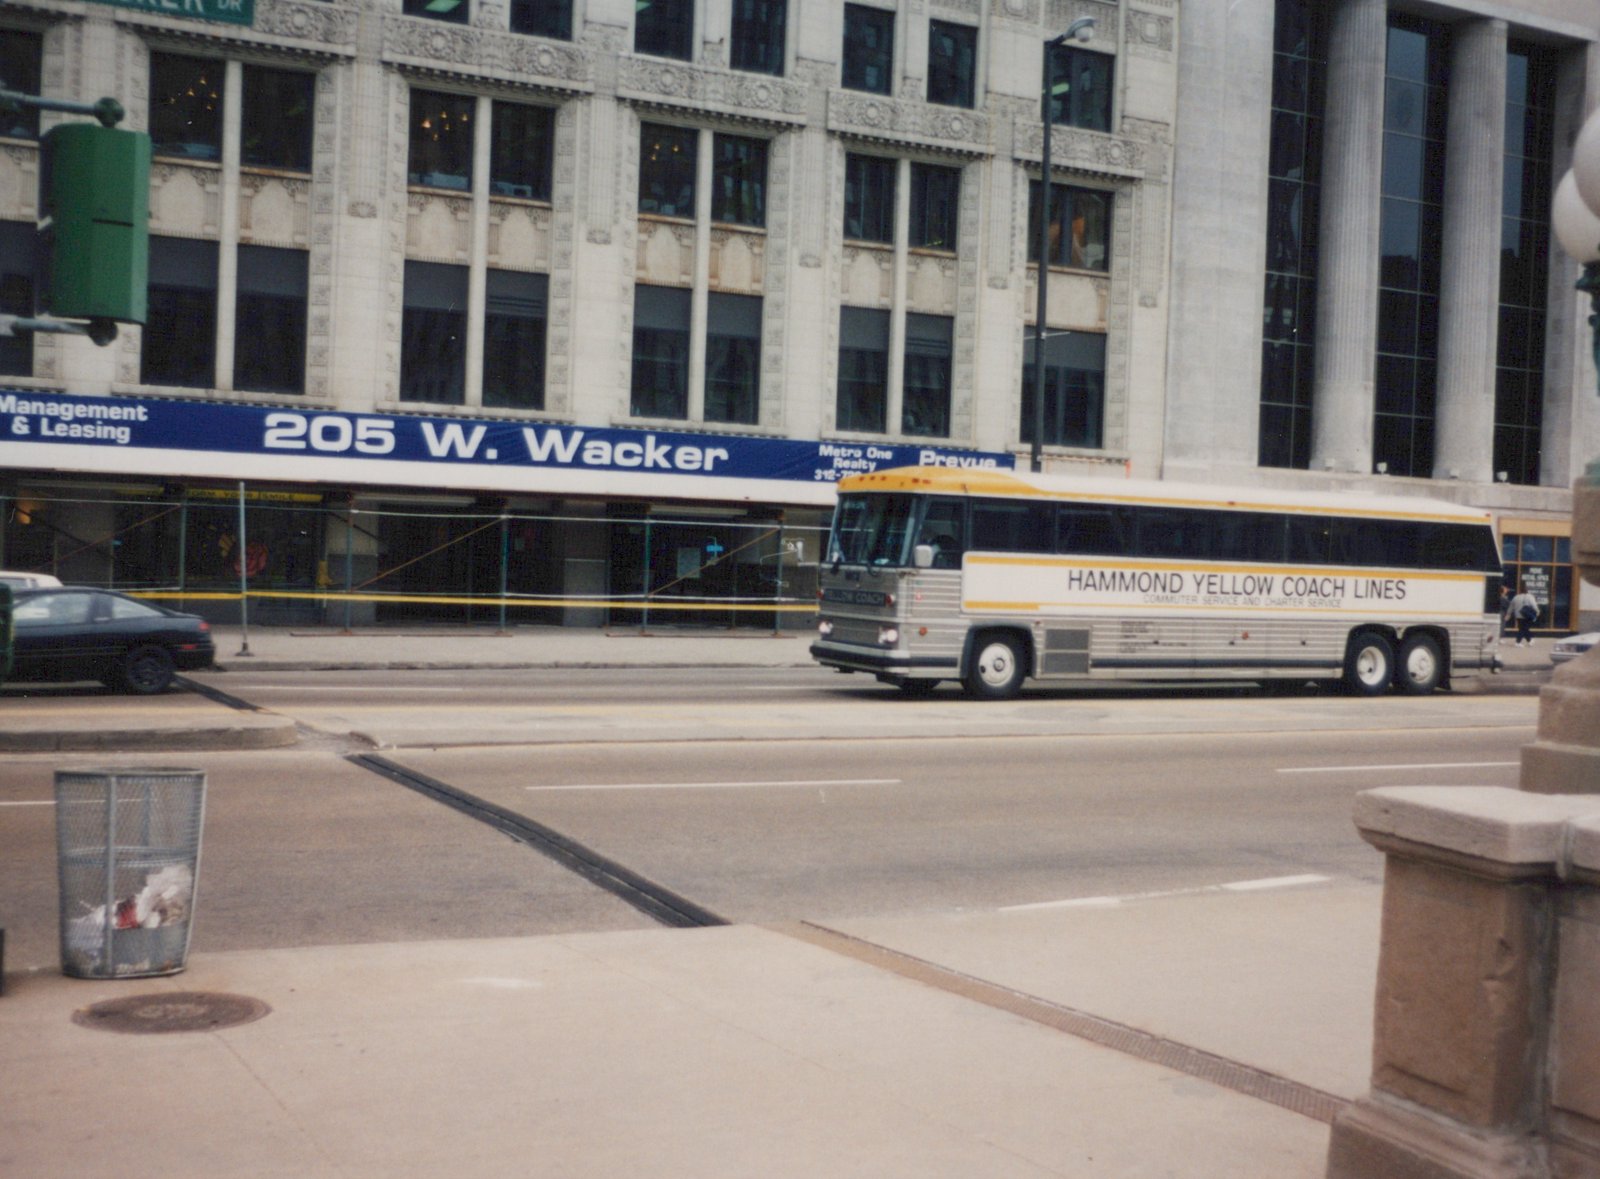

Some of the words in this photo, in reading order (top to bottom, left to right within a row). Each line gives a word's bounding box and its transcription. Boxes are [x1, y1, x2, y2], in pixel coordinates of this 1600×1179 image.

[0, 394, 148, 421] Management
[11, 416, 31, 435] &
[41, 417, 131, 444] Leasing
[264, 413, 395, 454] 205
[420, 421, 498, 460] W.
[522, 426, 729, 471] Wacker
[819, 444, 862, 458] Metro
[866, 447, 893, 460] One
[833, 457, 876, 473] Realty
[919, 451, 997, 467] Prevue
[1068, 569, 1184, 594] HAMMOND
[1193, 573, 1274, 596] YELLOW
[1282, 576, 1346, 598] COACH
[1354, 579, 1406, 600] LINES
[1144, 594, 1197, 604] COMMUTER
[1203, 596, 1238, 605] SERVICE
[1243, 597, 1261, 606] AND
[1264, 598, 1303, 607] CHARTER
[1308, 599, 1342, 608] SERVICE
